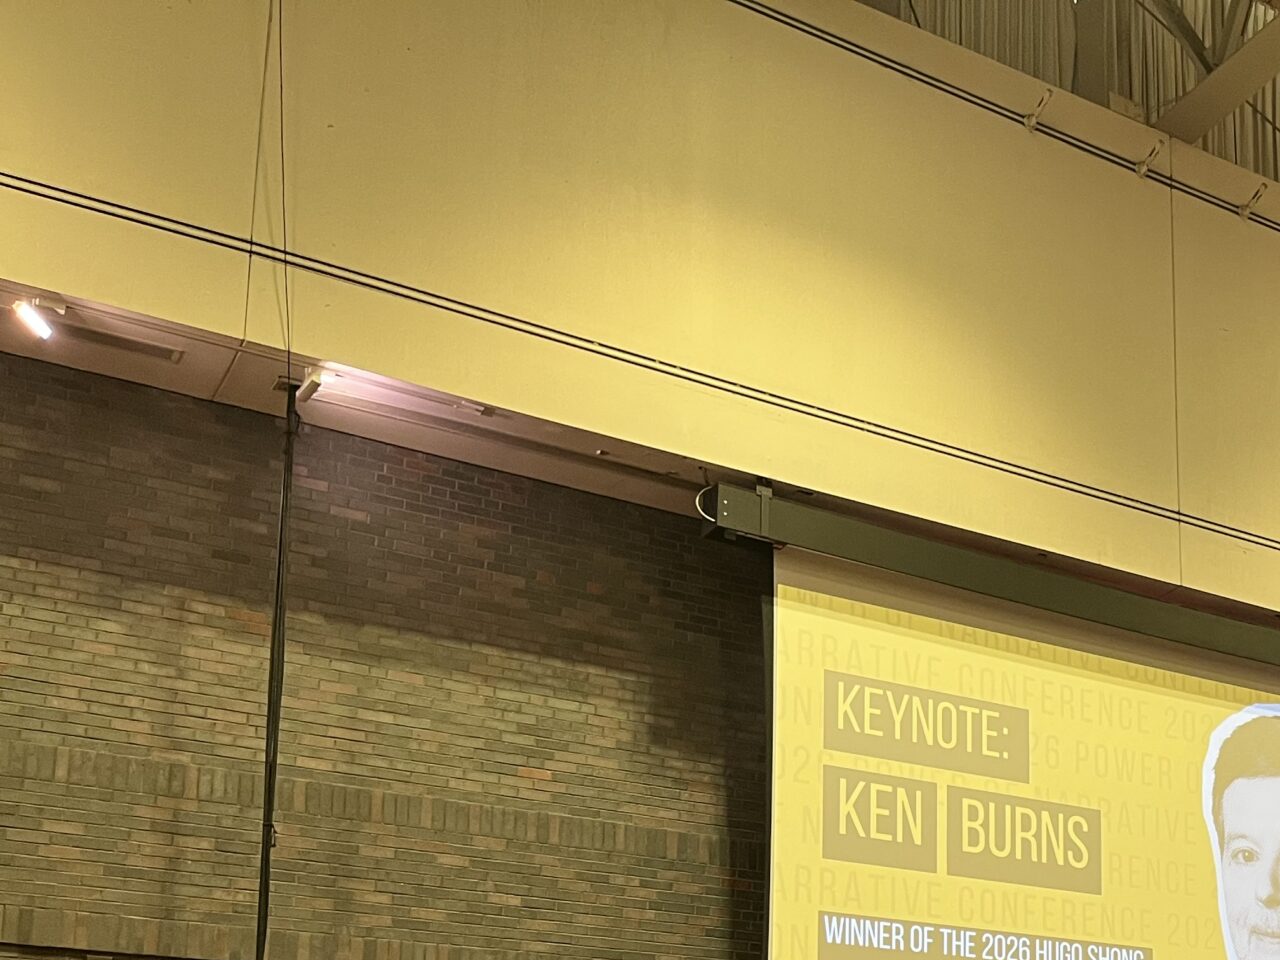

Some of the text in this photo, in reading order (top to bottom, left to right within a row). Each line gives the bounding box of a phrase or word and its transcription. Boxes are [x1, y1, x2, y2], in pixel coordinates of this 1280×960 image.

[836, 681, 1009, 760] KEYNOTE:
[838, 777, 923, 847] KEN
[960, 797, 1089, 869] BURNS
[824, 915, 905, 953] WINNER
[909, 924, 936, 954] OF
[939, 929, 977, 959] THE
